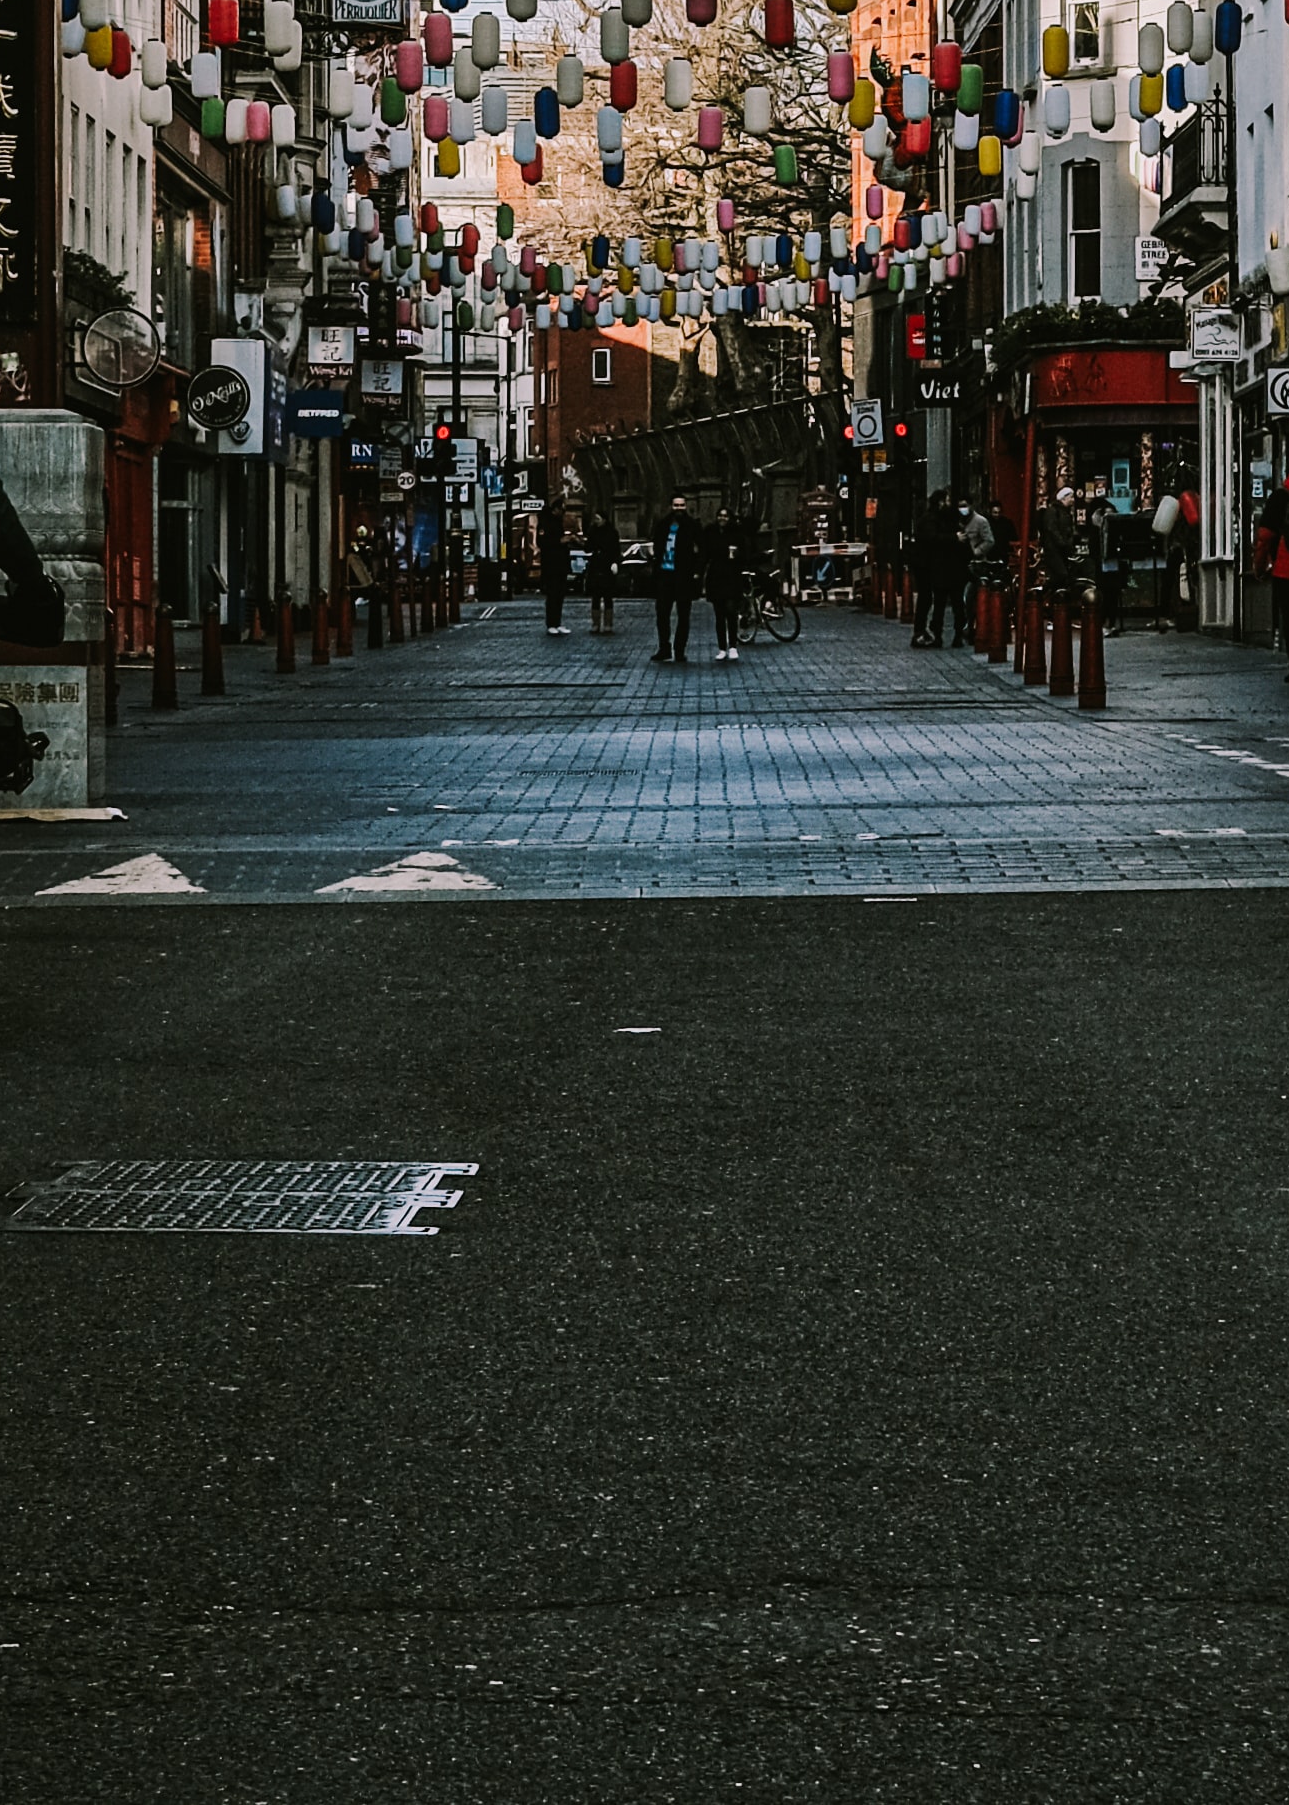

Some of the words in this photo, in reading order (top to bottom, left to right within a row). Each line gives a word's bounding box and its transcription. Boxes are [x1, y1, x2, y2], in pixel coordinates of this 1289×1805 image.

[321, 328, 343, 362] 旺記
[372, 361, 392, 392] 旺記
[920, 378, 961, 400] Viet
[399, 476, 414, 485] 20
